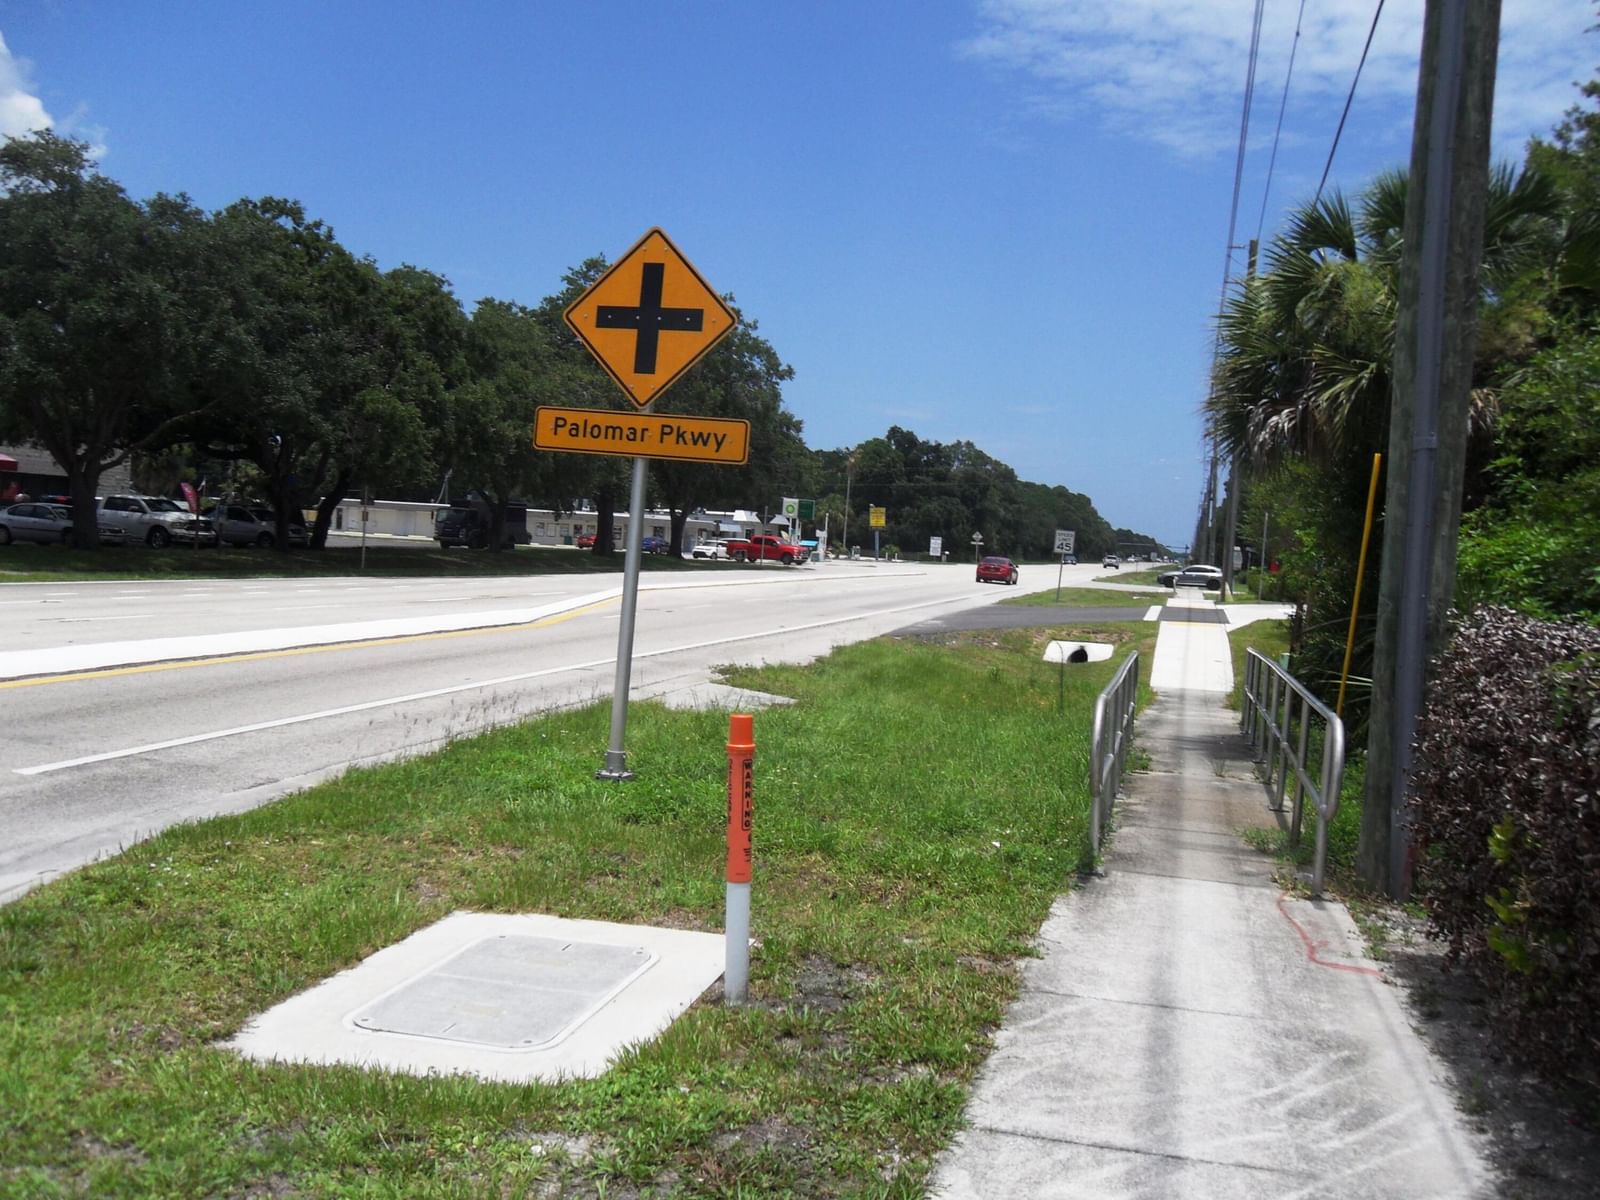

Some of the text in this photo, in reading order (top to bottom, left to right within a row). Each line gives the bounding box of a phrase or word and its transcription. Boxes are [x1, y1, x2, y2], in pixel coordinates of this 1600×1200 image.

[553, 416, 727, 453] Palomar Pkwy
[1056, 542, 1072, 552] 45
[744, 762, 752, 828] WARNING
